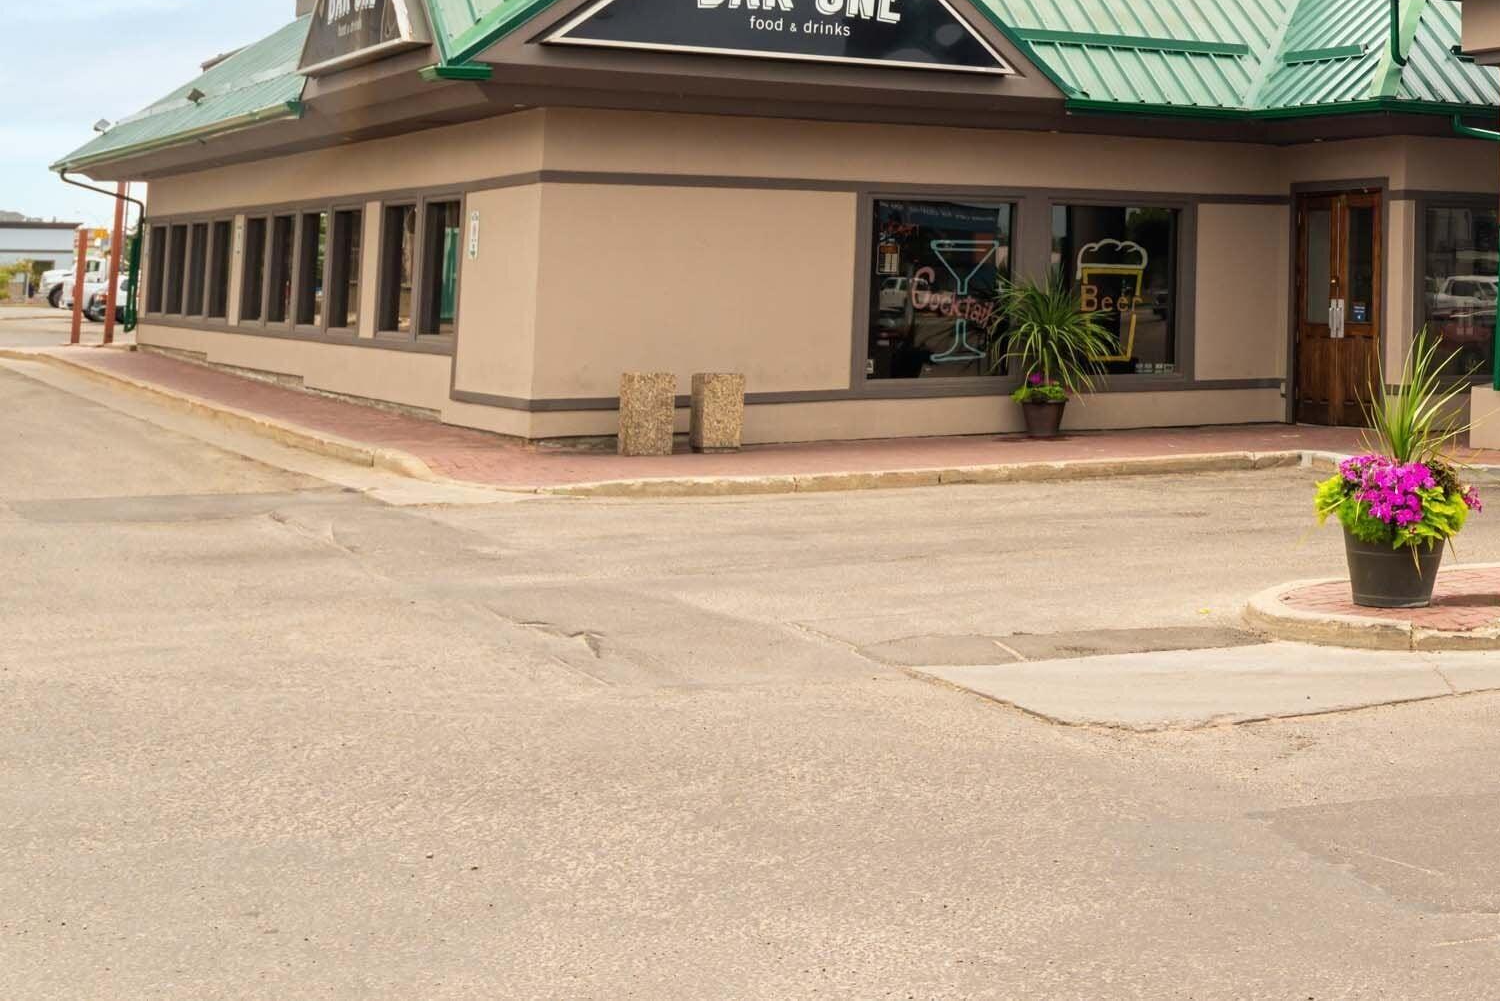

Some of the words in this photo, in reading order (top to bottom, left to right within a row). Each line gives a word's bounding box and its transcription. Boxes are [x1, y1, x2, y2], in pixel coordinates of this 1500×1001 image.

[750, 15, 784, 31] food
[789, 22, 797, 32] &
[803, 19, 851, 37] drinks
[1080, 284, 1143, 312] Beer
